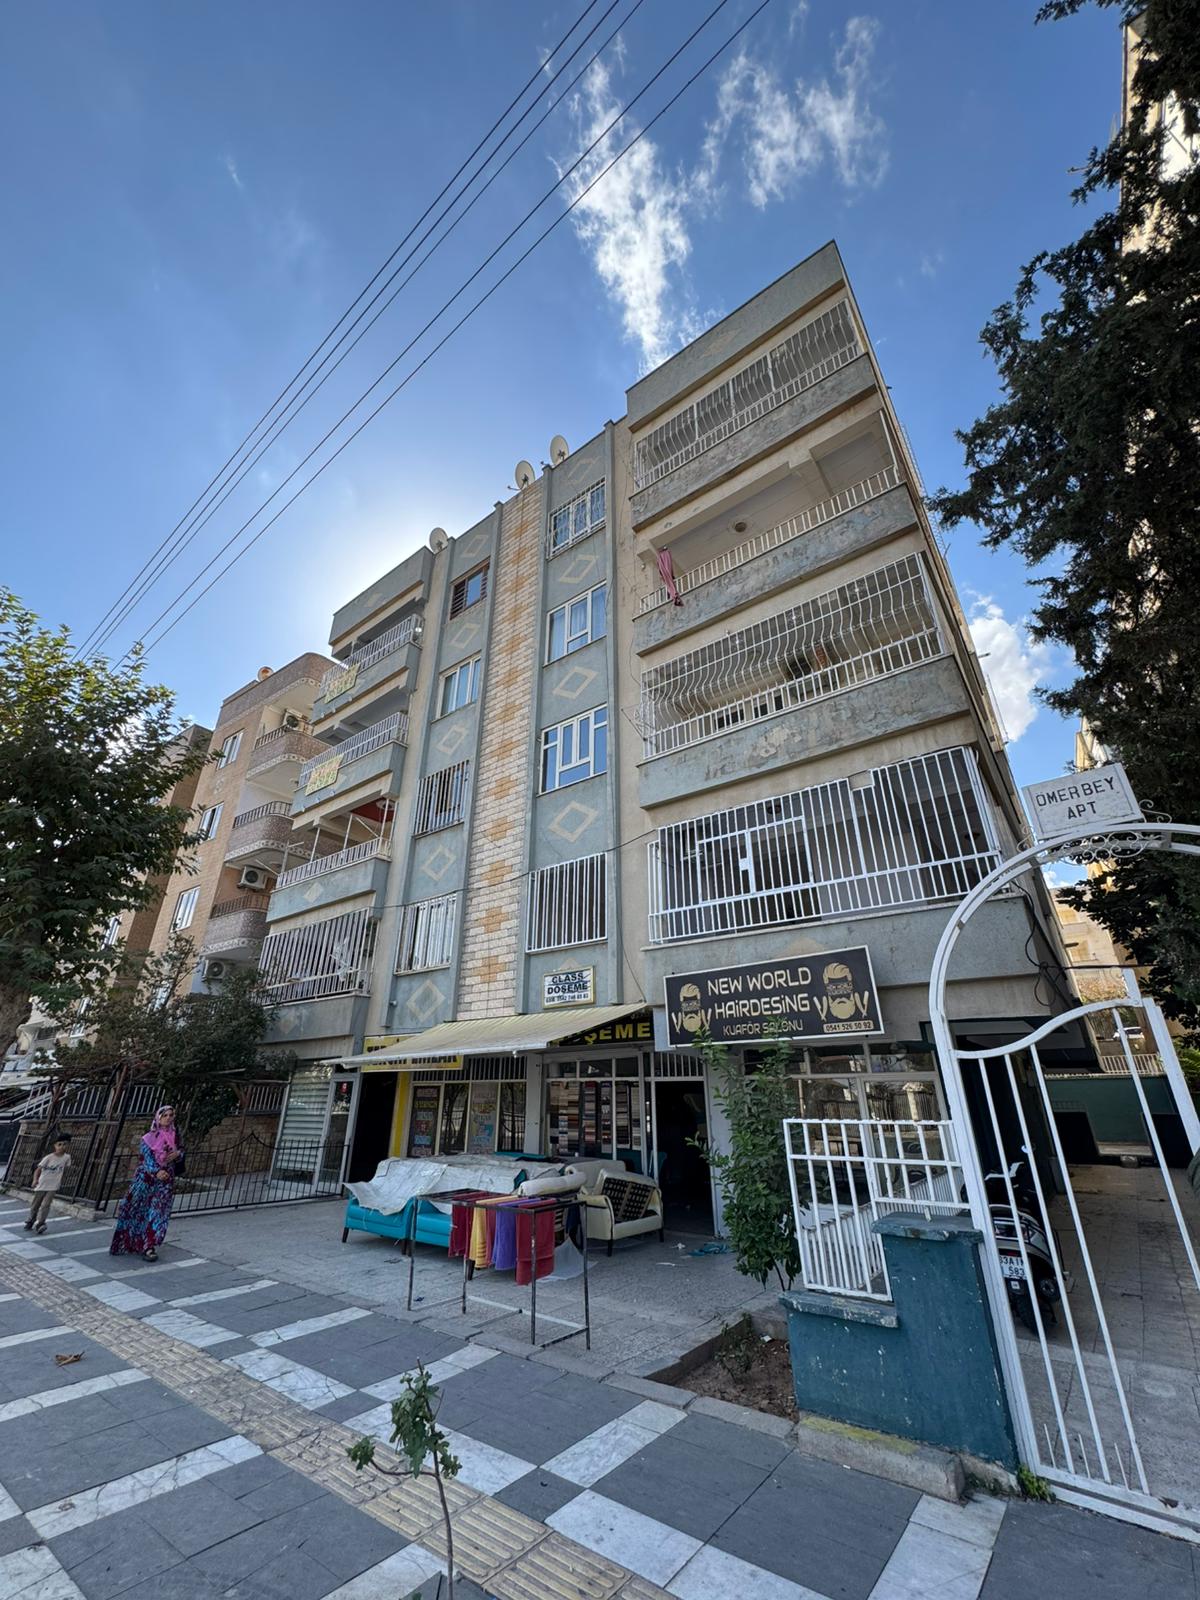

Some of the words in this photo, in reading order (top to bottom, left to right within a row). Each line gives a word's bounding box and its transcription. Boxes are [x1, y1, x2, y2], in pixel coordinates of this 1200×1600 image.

[1067, 801, 1097, 819] APT
[707, 976, 744, 997] NEW
[746, 966, 812, 992] WORLD
